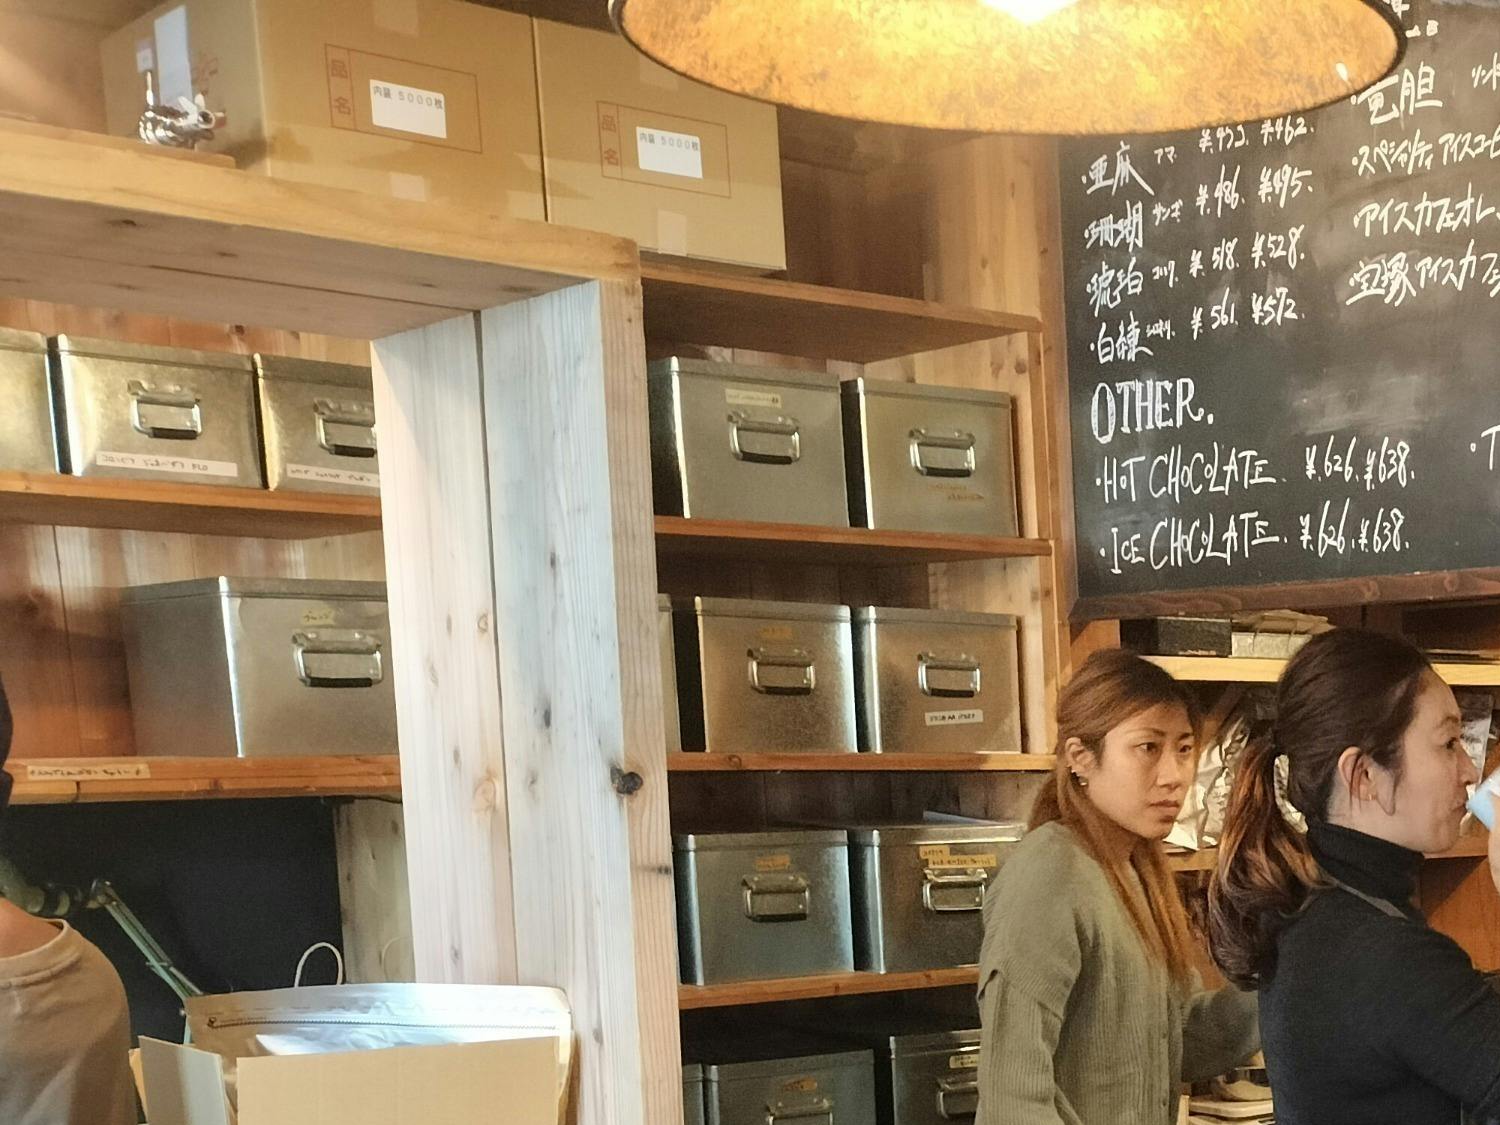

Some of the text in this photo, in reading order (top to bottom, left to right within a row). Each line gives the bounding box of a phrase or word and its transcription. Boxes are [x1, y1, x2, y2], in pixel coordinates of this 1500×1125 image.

[1091, 378, 1214, 444] OTHER.
[1104, 456, 1145, 503] HOT
[1110, 527, 1145, 574] ICE
